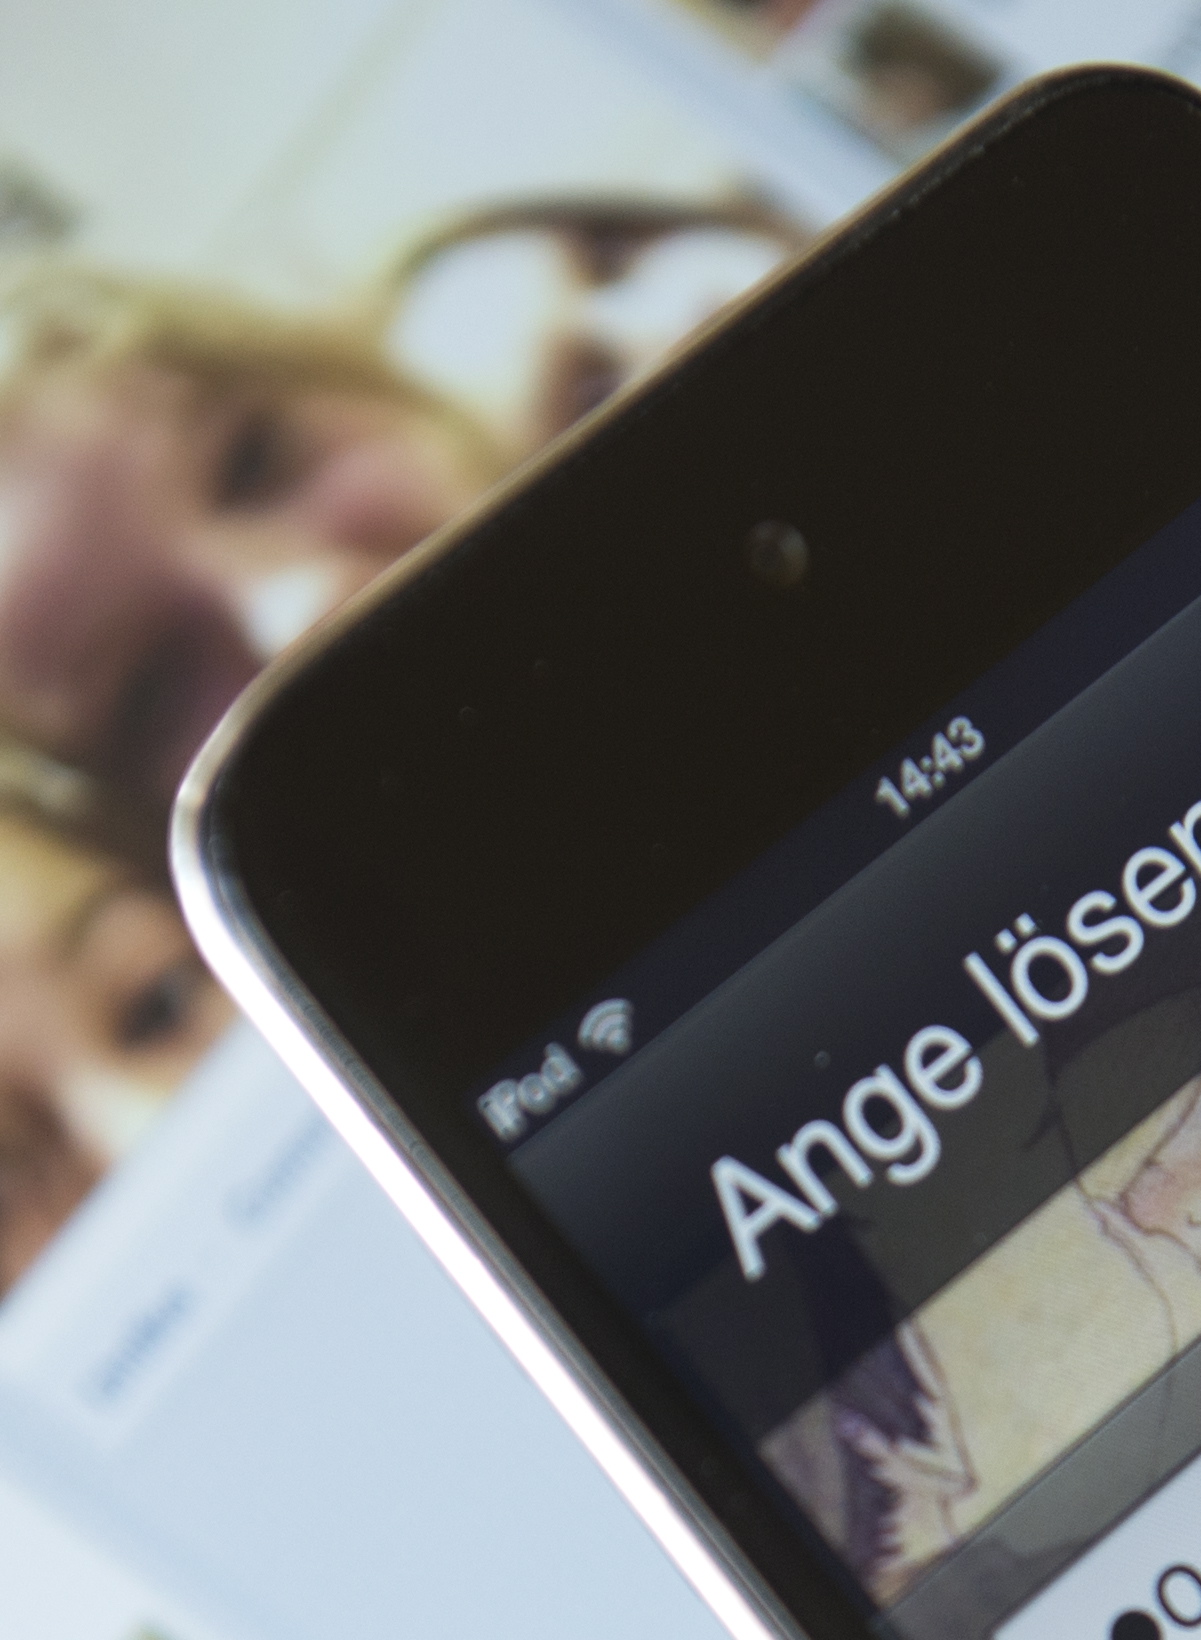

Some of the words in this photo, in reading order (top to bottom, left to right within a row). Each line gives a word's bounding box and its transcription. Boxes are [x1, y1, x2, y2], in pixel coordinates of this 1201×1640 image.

[875, 715, 986, 817] 14:43
[477, 1040, 584, 1142] iPod
[710, 1023, 985, 1280] Ange
